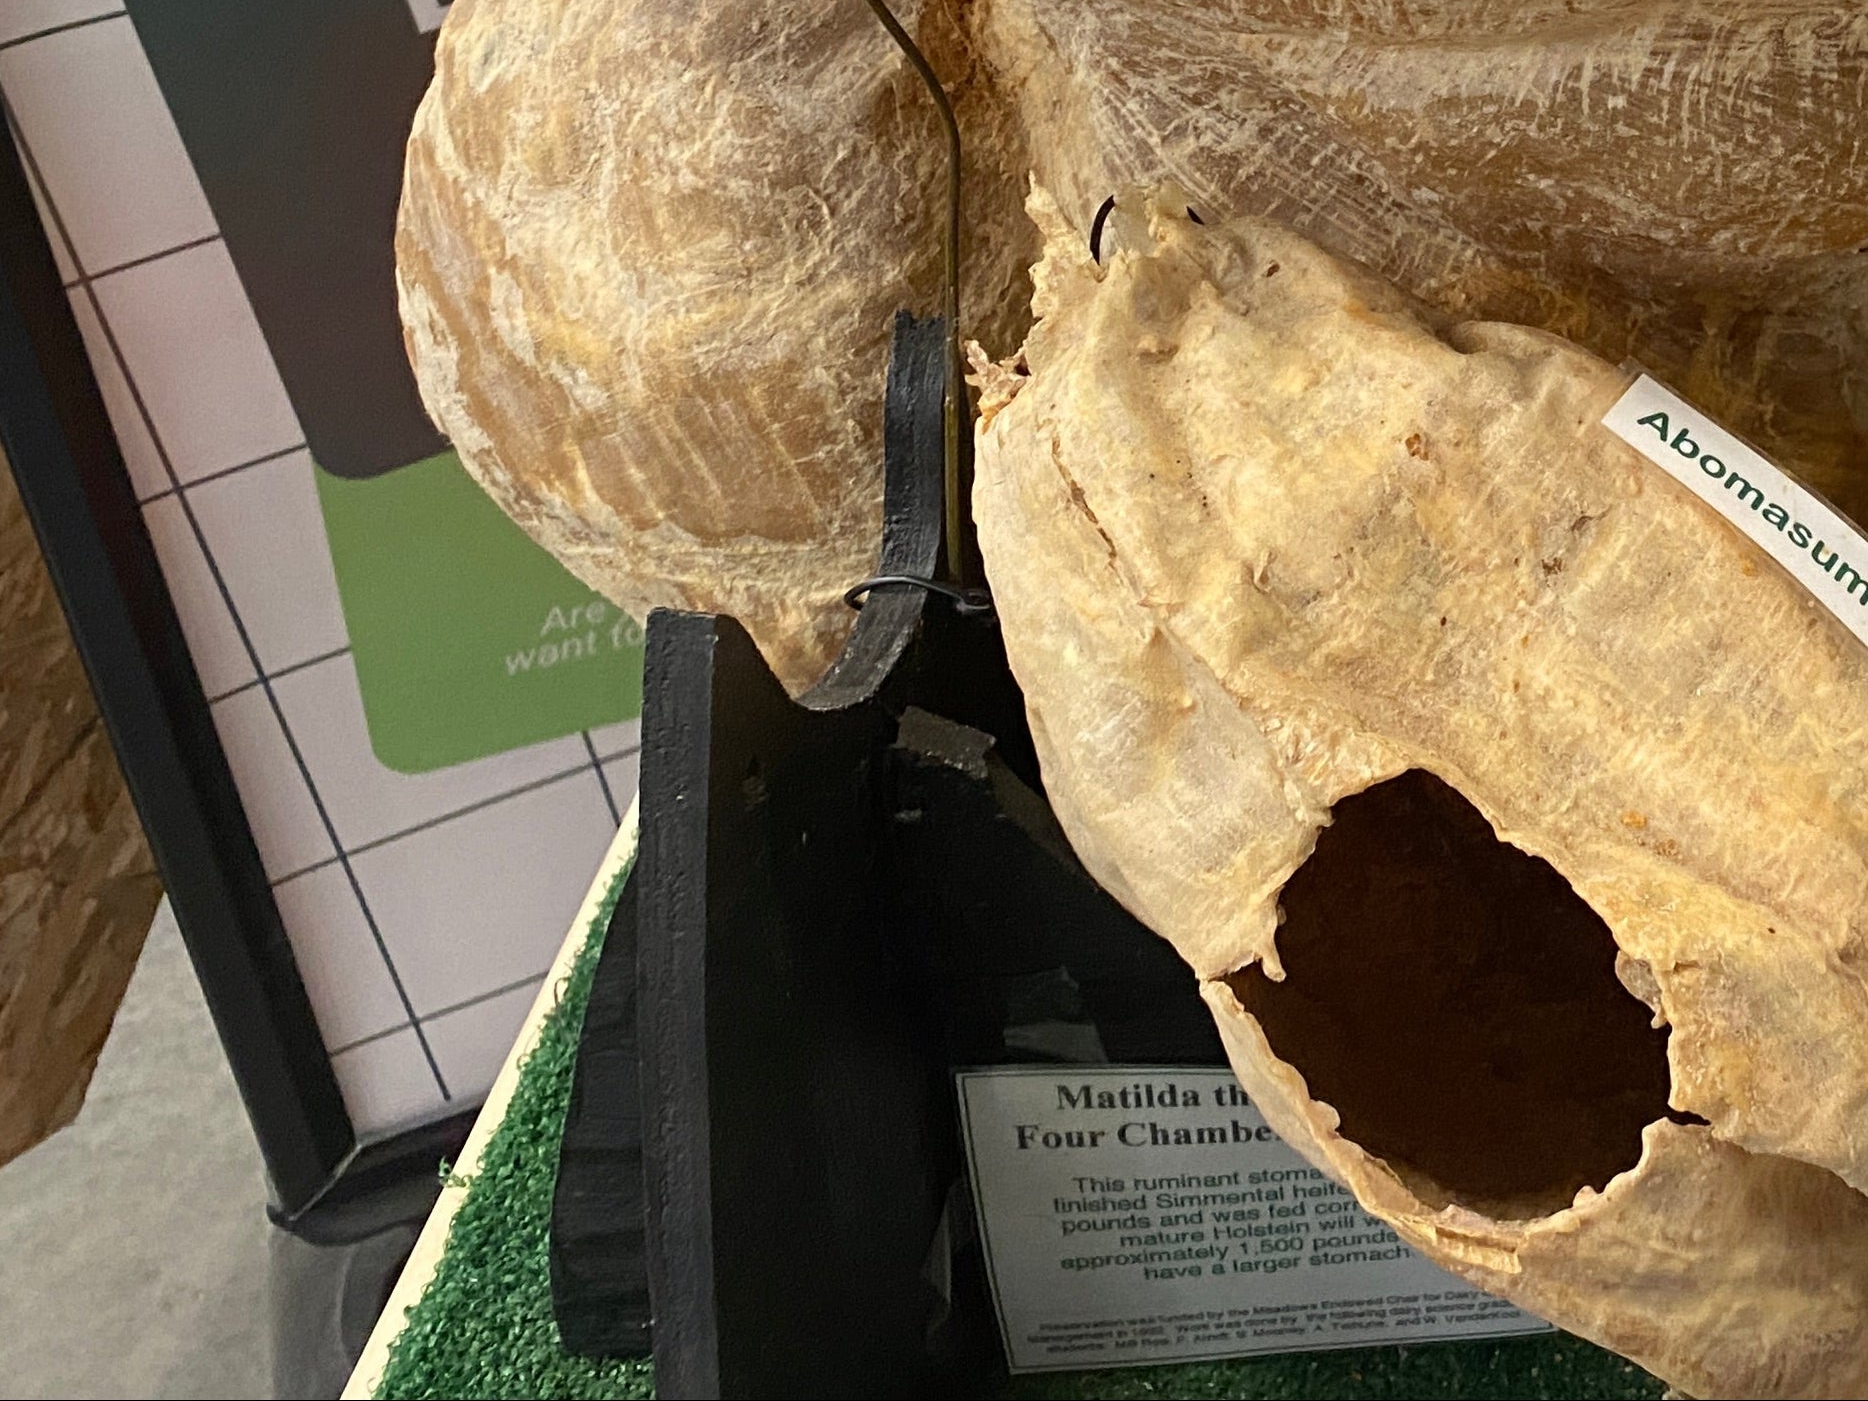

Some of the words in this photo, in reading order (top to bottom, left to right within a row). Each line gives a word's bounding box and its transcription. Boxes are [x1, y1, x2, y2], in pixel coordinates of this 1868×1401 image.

[540, 601, 605, 636] Are
[505, 630, 597, 677] want
[1056, 1083, 1202, 1110] Matilda
[1213, 1083, 1250, 1107] th
[1013, 1123, 1106, 1149] Four
[1117, 1120, 1282, 1146] Chambe
[1053, 1193, 1147, 1213] finished
[1156, 1186, 1284, 1210] Simmental
[1293, 1181, 1351, 1199] heife
[1072, 1176, 1125, 1194] This
[1133, 1172, 1240, 1192] ruminant
[1247, 1168, 1323, 1185] stoma
[1062, 1215, 1150, 1237] pounds
[1160, 1210, 1204, 1227] and
[1213, 1207, 1260, 1223] was
[1268, 1201, 1306, 1218] fed
[1119, 1230, 1205, 1247] mature
[1213, 1221, 1310, 1241] Holstein
[1318, 1216, 1355, 1232] will
[1060, 1243, 1229, 1272] approximately
[1313, 1229, 1400, 1252] pounds
[1144, 1264, 1201, 1280] have
[1211, 1262, 1226, 1276] a
[1233, 1256, 1301, 1274] larger
[1309, 1245, 1411, 1266] stomach
